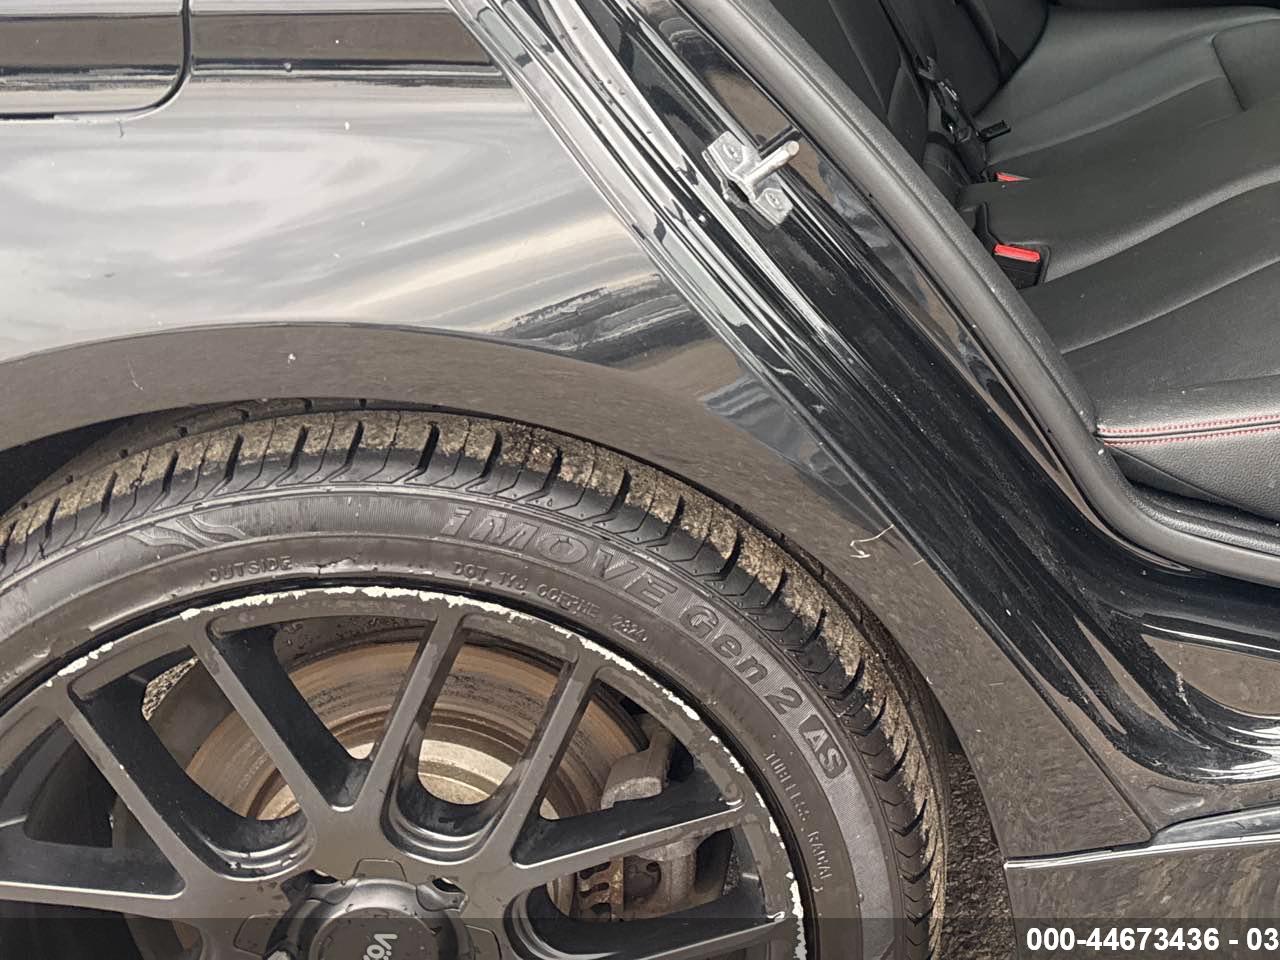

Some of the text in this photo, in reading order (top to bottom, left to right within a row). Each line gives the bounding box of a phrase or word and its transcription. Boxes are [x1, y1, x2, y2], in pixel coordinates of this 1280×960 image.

[208, 556, 293, 582] OUTSIDE
[679, 605, 768, 685] Gen
[764, 686, 804, 716] 2
[802, 728, 842, 773] AS
